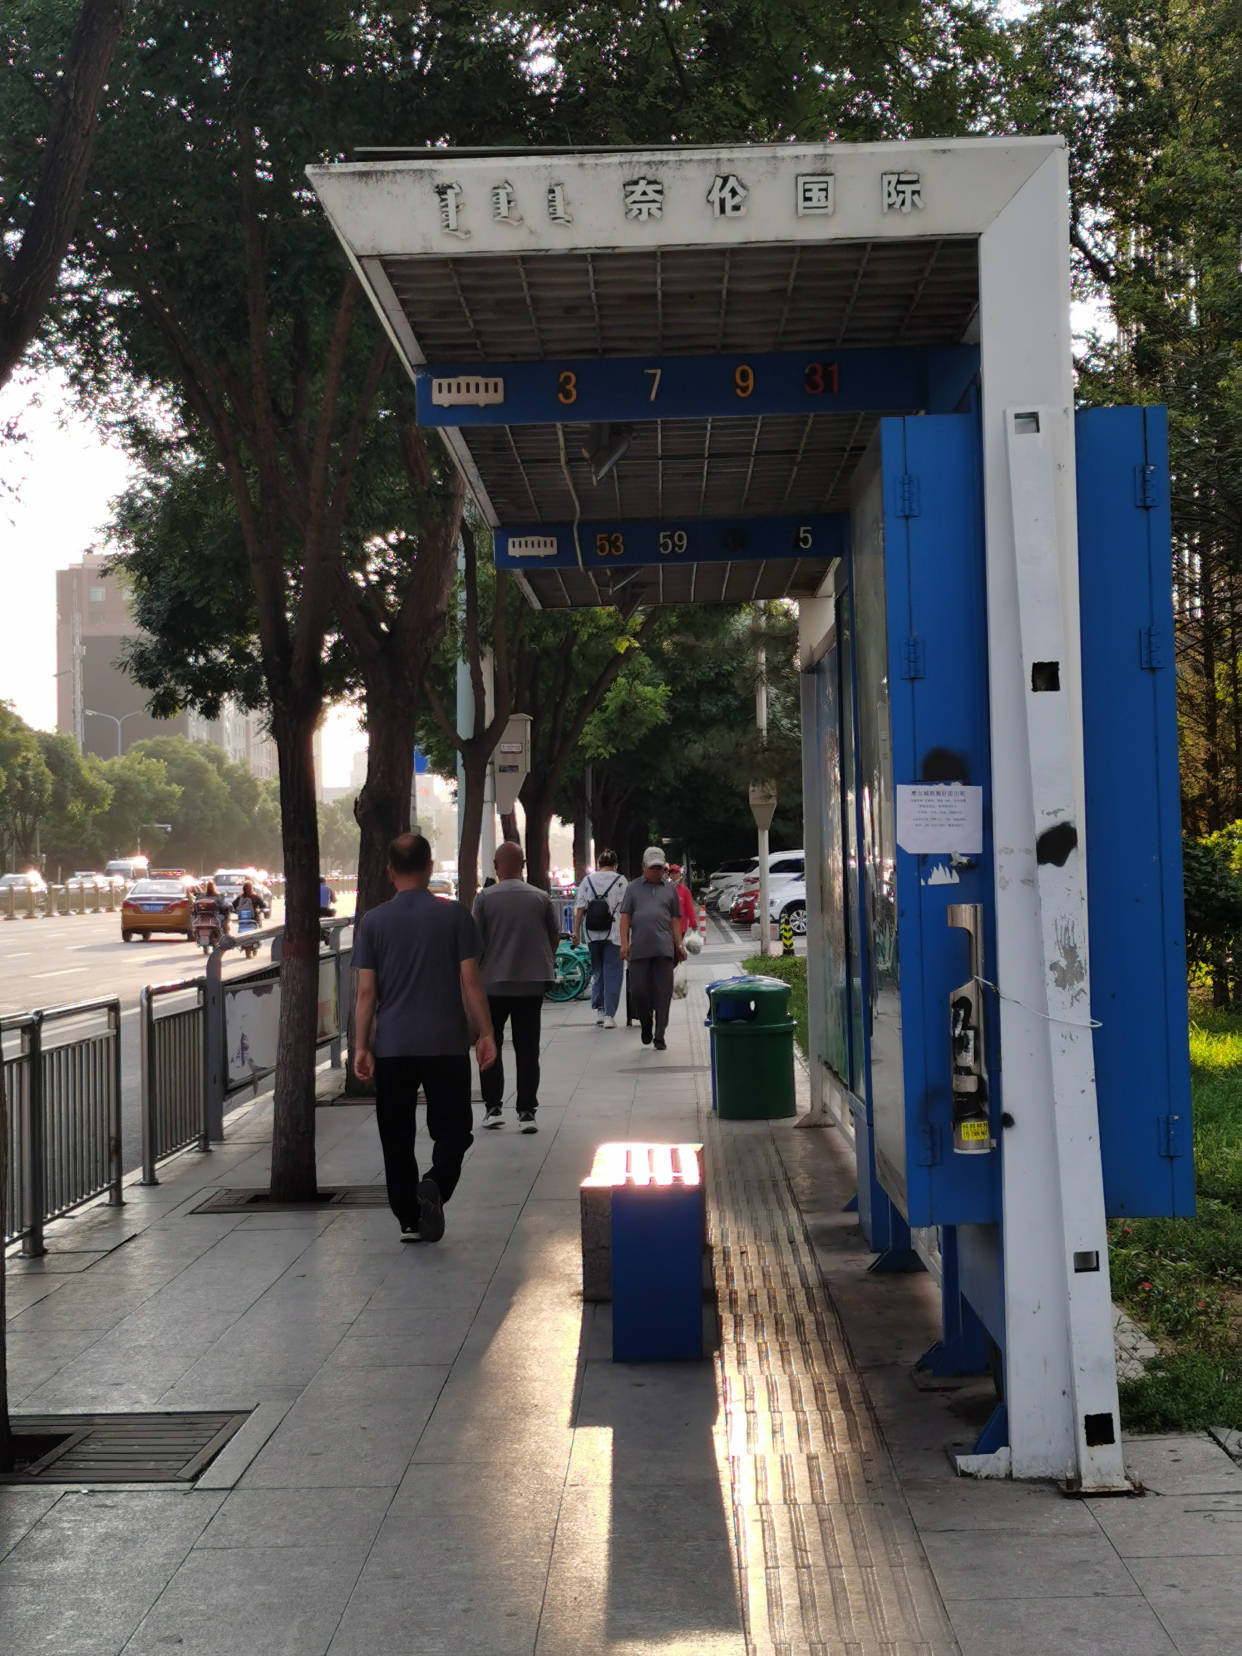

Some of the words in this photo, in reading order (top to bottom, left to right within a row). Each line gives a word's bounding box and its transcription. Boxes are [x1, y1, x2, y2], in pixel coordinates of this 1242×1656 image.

[623, 172, 925, 222] 奈伦国际
[557, 371, 578, 405] 3
[643, 368, 662, 401] 7
[734, 364, 754, 398] 9
[803, 361, 840, 396] 31
[595, 532, 625, 557] 53
[658, 530, 688, 554] 59
